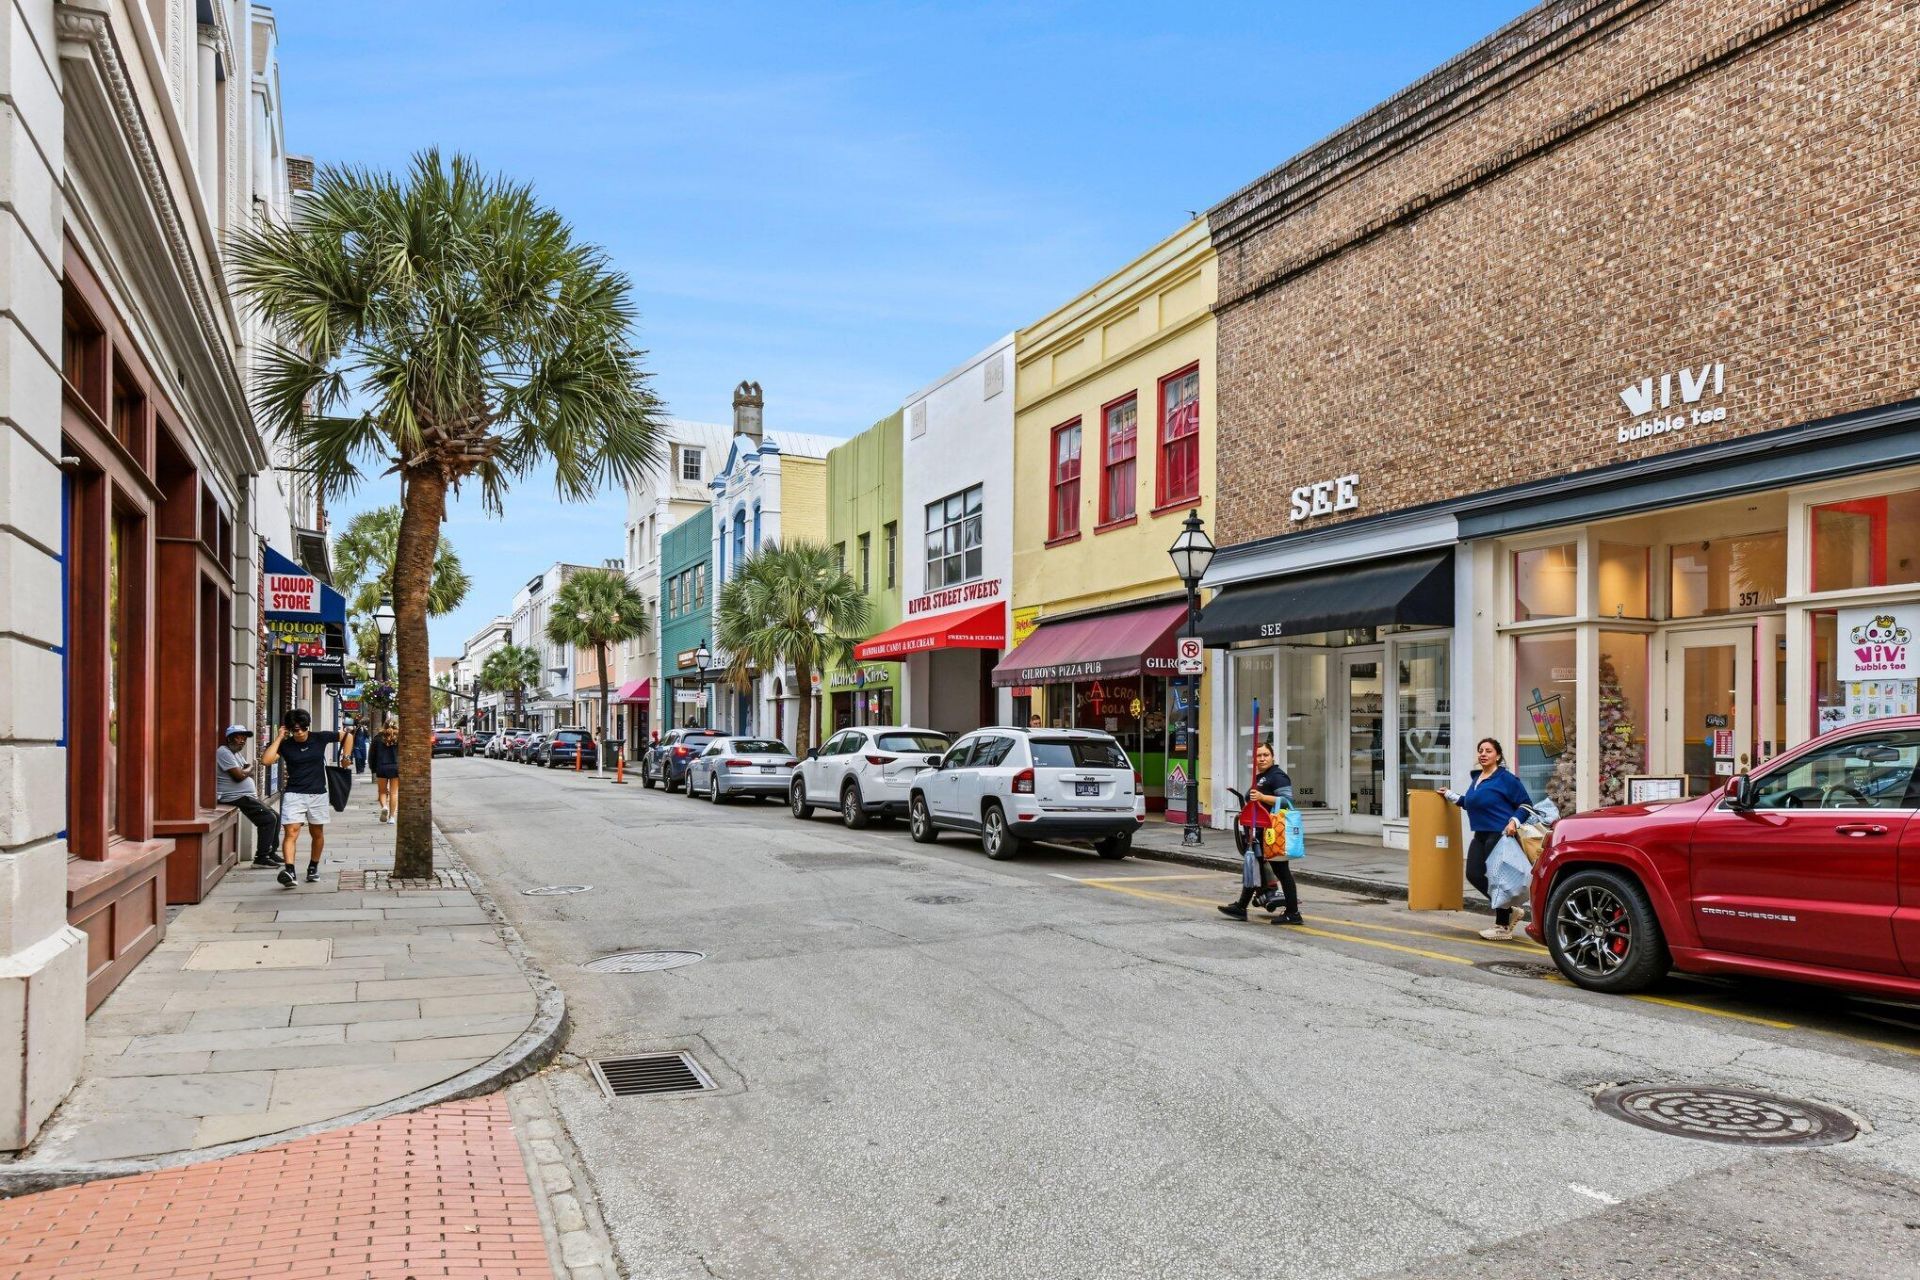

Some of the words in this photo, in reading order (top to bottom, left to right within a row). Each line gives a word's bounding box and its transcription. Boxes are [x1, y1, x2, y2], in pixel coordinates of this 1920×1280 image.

[1618, 415, 1685, 443] bubble
[1690, 406, 1726, 426] tea
[1290, 474, 1360, 521] SEE
[270, 576, 314, 593] LIQUOR
[272, 593, 311, 610] STORE
[908, 595, 932, 615] RIVER
[932, 588, 962, 609] STREET
[1738, 592, 1759, 607] 357
[268, 621, 326, 635] LIQUOR
[1260, 622, 1282, 636] SEE
[886, 642, 901, 653] CANDY
[916, 637, 935, 648] CREAM
[1021, 665, 1056, 680] GILROY'S
[1058, 663, 1082, 677] PIZZA
[1085, 661, 1102, 674] PUB
[1855, 662, 1888, 671] bubble
[1890, 662, 1906, 670] tea
[1300, 787, 1315, 795] SEE
[1701, 907, 1736, 916] GRAND
[1737, 911, 1797, 922] CHEROKEE
